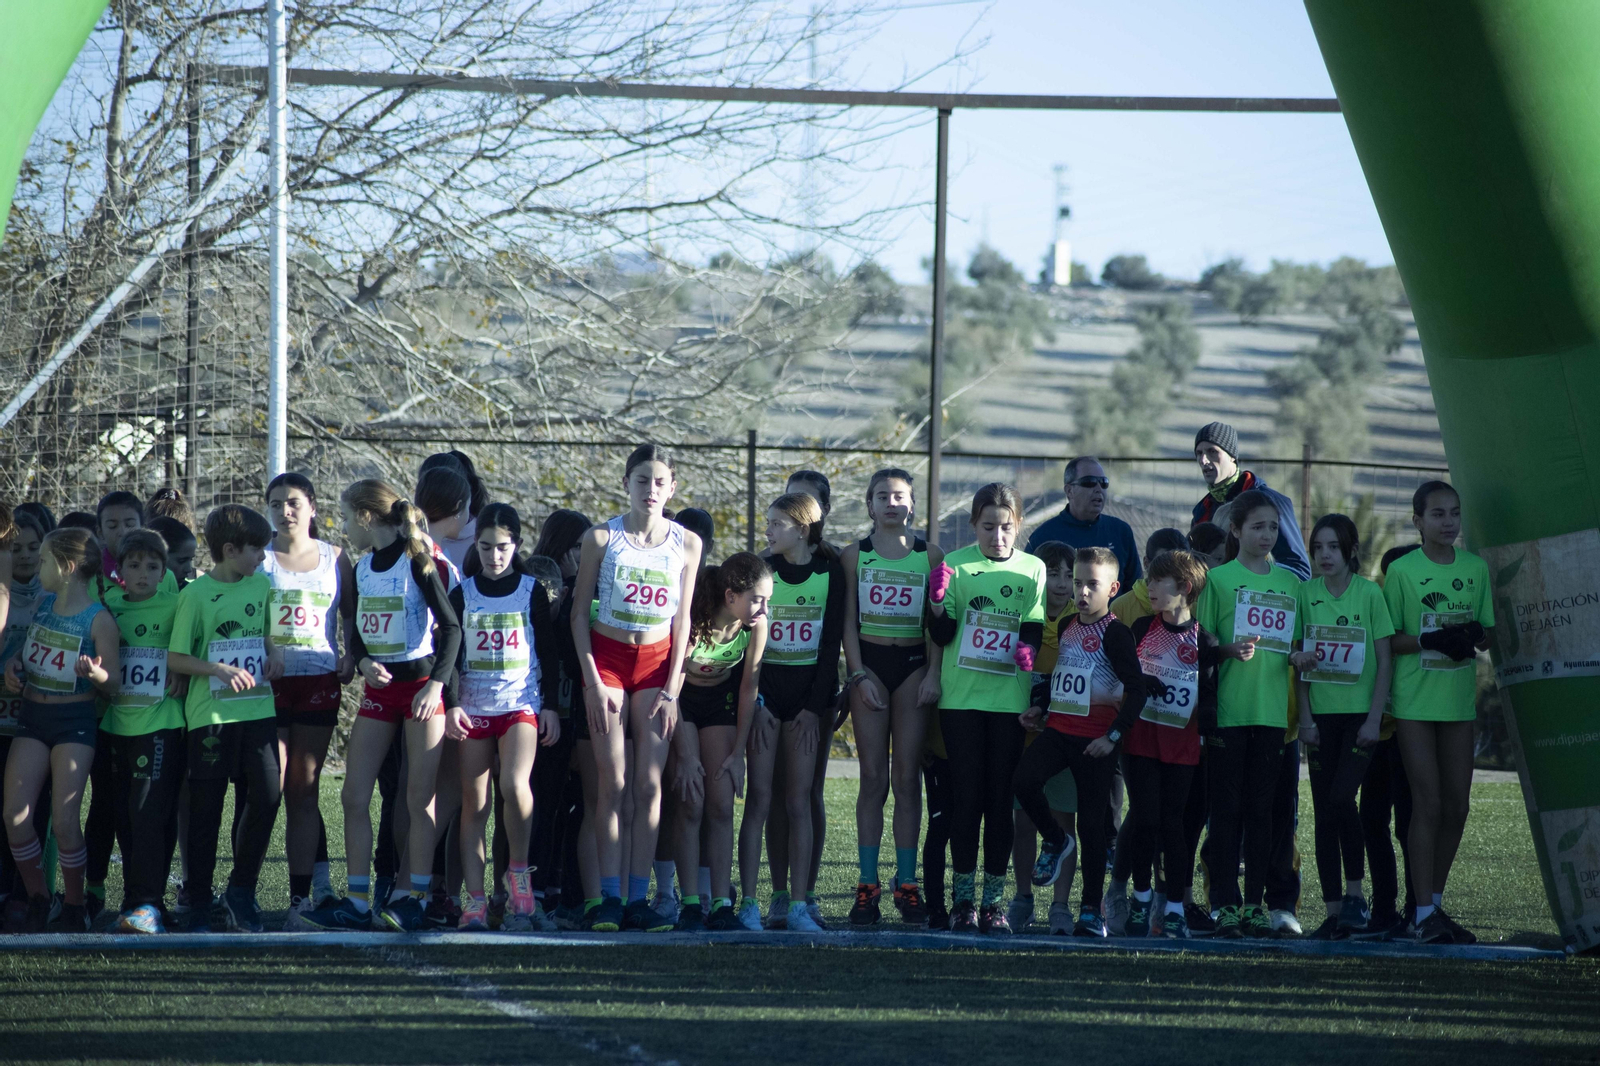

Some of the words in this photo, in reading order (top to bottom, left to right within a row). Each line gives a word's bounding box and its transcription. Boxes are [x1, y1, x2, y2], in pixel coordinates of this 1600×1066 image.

[622, 583, 668, 608] 296
[869, 585, 912, 607] 625
[1516, 592, 1600, 617] DIPUTACIÓN
[361, 613, 393, 634] 297
[1247, 606, 1286, 631] 668
[1519, 621, 1536, 633] DE
[1539, 614, 1572, 631] JAÉN
[476, 630, 519, 651] 294
[770, 621, 812, 642] 616
[972, 628, 1011, 653] 624
[28, 643, 65, 671] 274
[1315, 641, 1354, 663] 577
[120, 664, 161, 687] 164
[1155, 664, 1169, 677] POPULAR
[1503, 664, 1534, 677] DEPORTES
[1051, 671, 1086, 695] 1160
[1162, 684, 1191, 708] 63
[1533, 731, 1600, 748] www.dipujae
[152, 736, 164, 781] Joma
[1580, 870, 1600, 883] DIP
